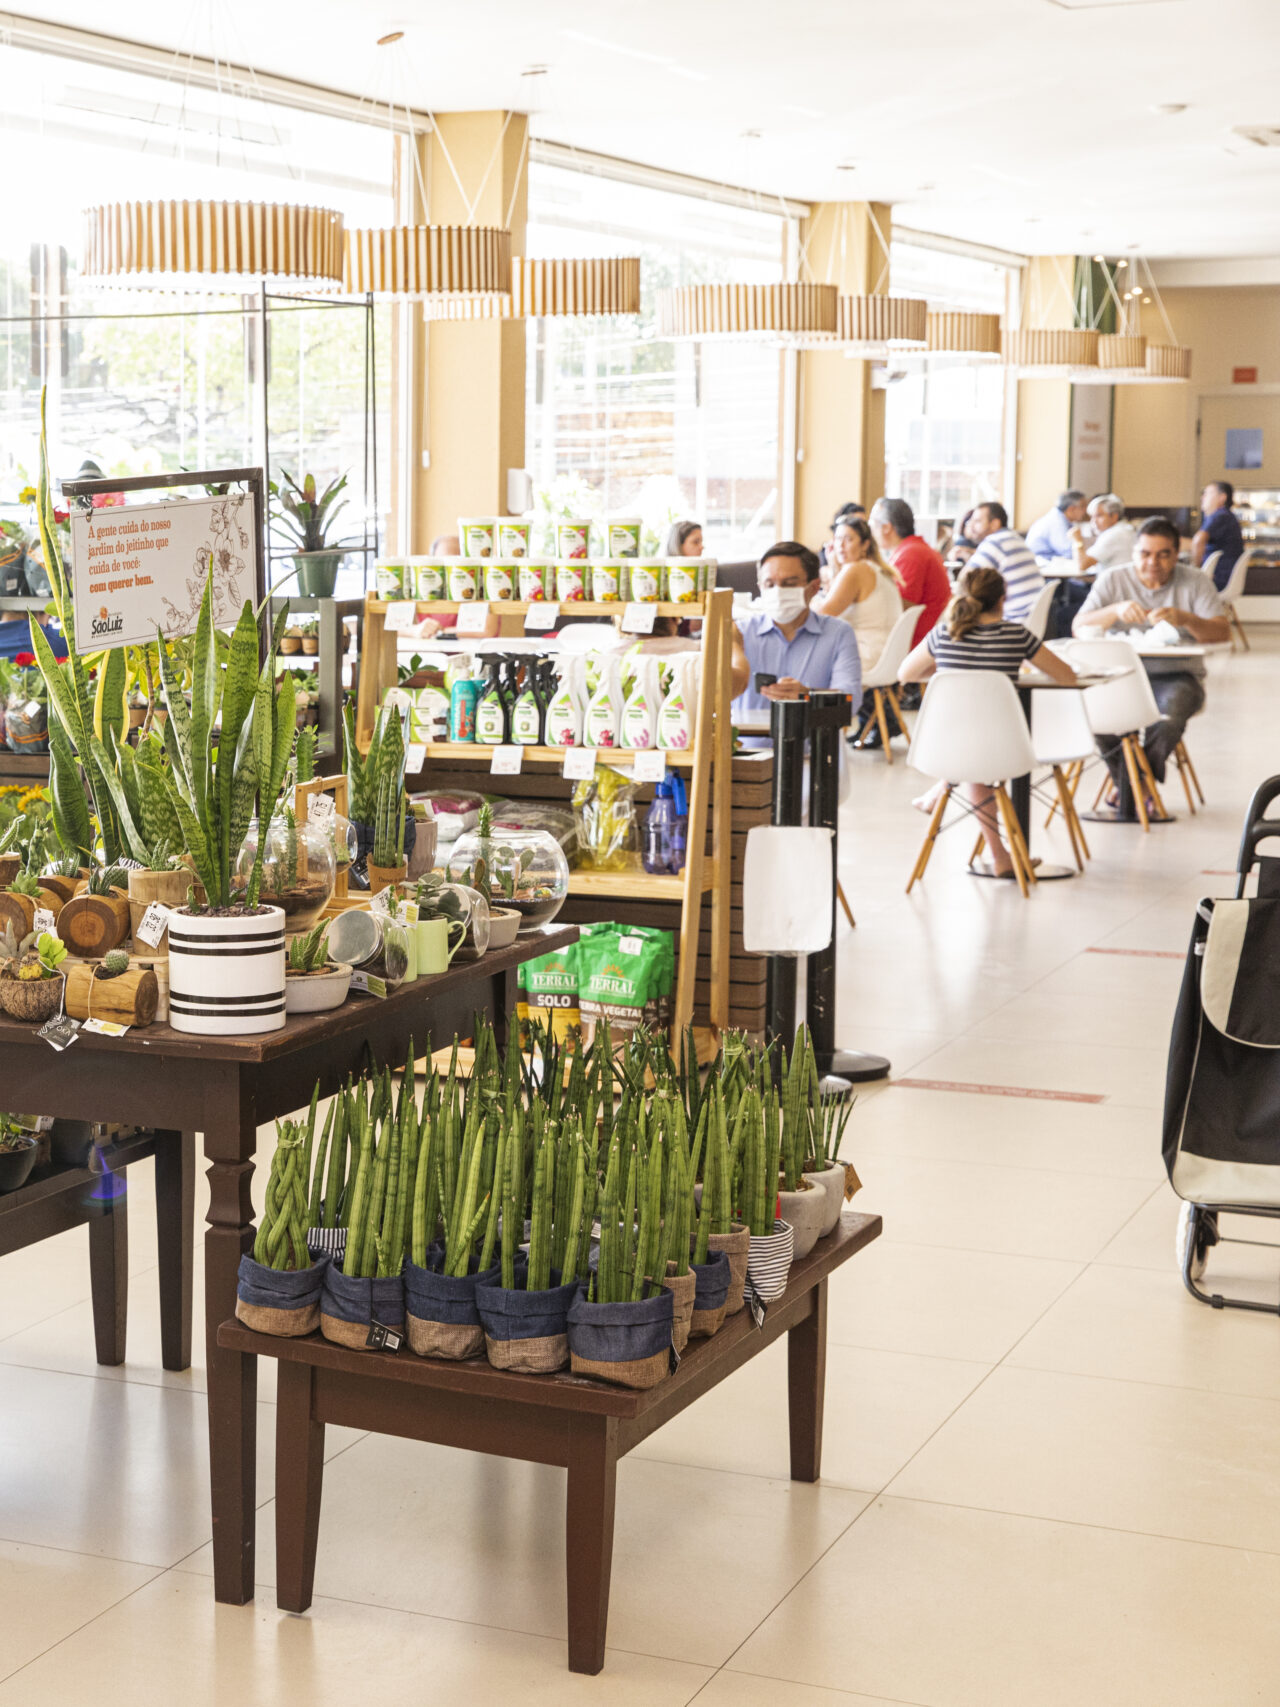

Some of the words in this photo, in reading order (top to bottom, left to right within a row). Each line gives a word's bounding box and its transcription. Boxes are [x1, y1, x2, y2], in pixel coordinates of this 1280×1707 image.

[88, 525, 95, 538] A
[97, 524, 117, 540] gente
[119, 521, 139, 535] cuida
[140, 520, 149, 532] do
[151, 520, 171, 531] nosso
[88, 542, 114, 560] jardim
[116, 540, 125, 553] do
[126, 537, 154, 555] jeitinho
[156, 538, 169, 551] que
[89, 560, 110, 575] cuida
[112, 559, 121, 572] de
[89, 582, 107, 593] com
[108, 578, 133, 593] querer
[134, 574, 154, 586] bem.
[532, 974, 578, 987] TERRAL
[590, 977, 637, 996] TERRAL
[537, 994, 571, 1008] SOLO
